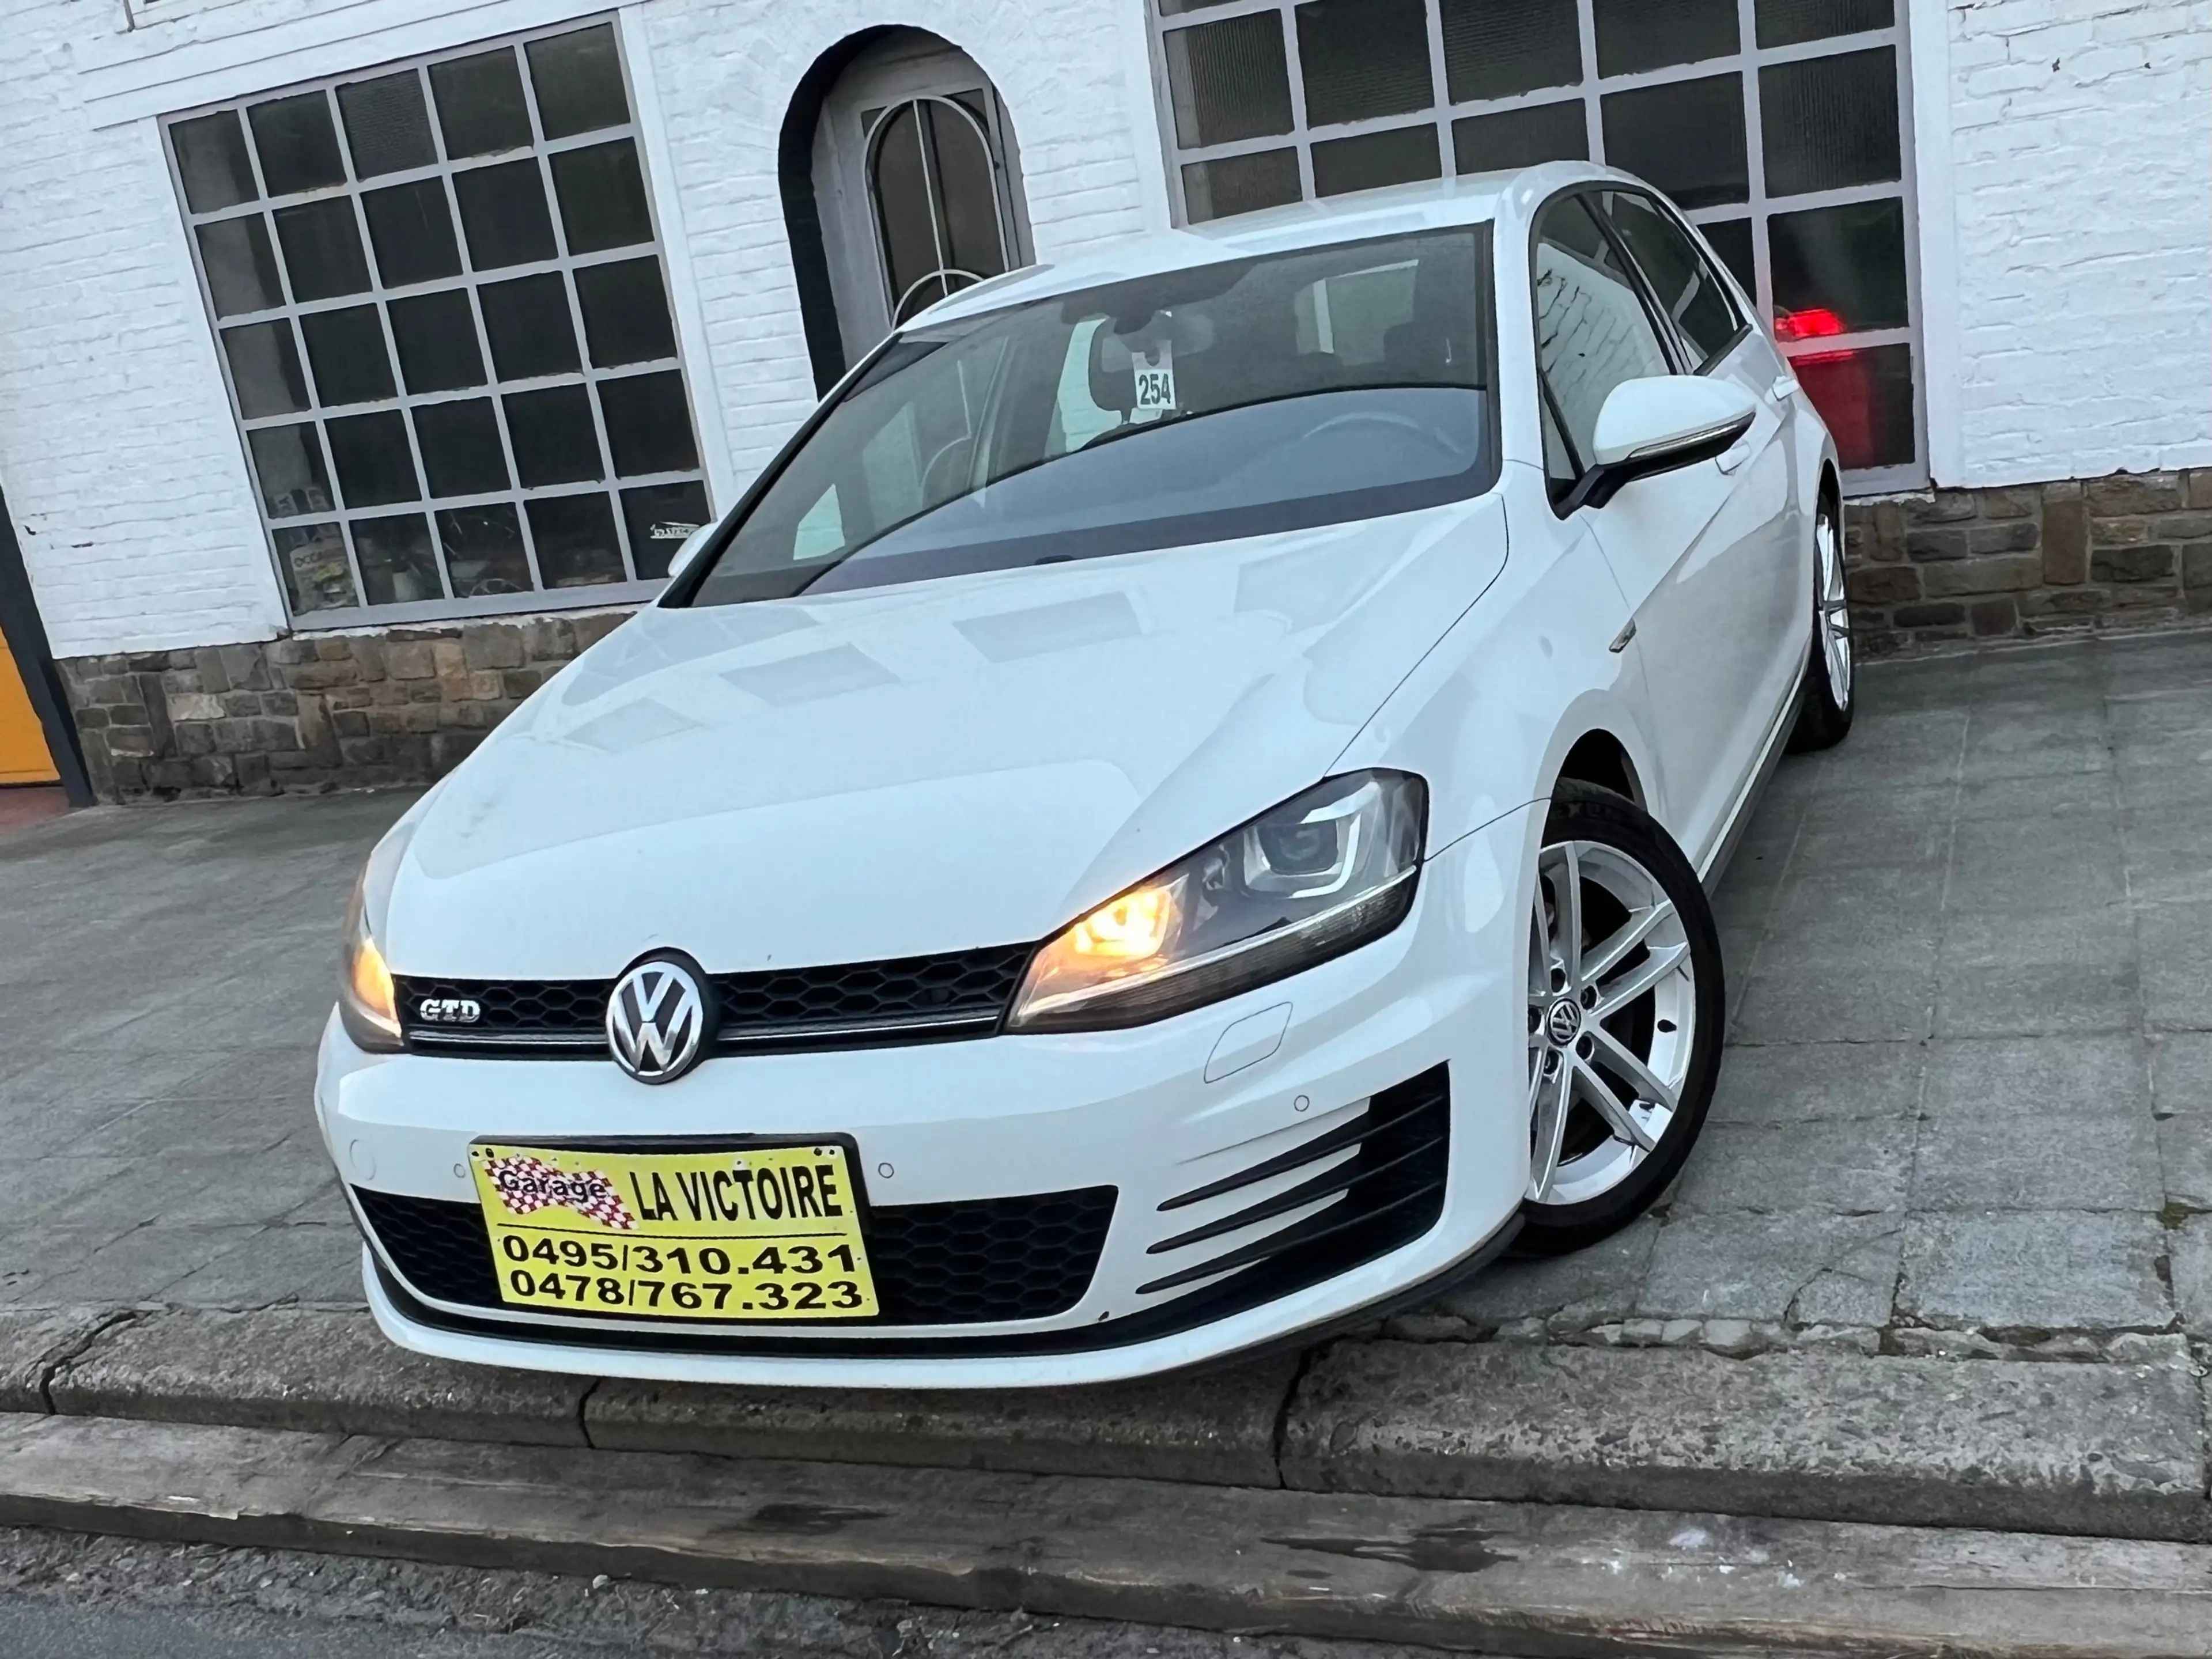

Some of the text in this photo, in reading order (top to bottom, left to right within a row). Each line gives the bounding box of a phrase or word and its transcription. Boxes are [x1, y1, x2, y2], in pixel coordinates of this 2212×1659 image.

[1139, 374, 1171, 405] 254
[420, 999, 481, 1022] GTD
[608, 962, 702, 1077] VW
[498, 1169, 606, 1203] Garage
[629, 1164, 842, 1221] LA VICTOIRE
[503, 1235, 856, 1274] 0495/310.431
[511, 1270, 862, 1310] 0478/767.323
